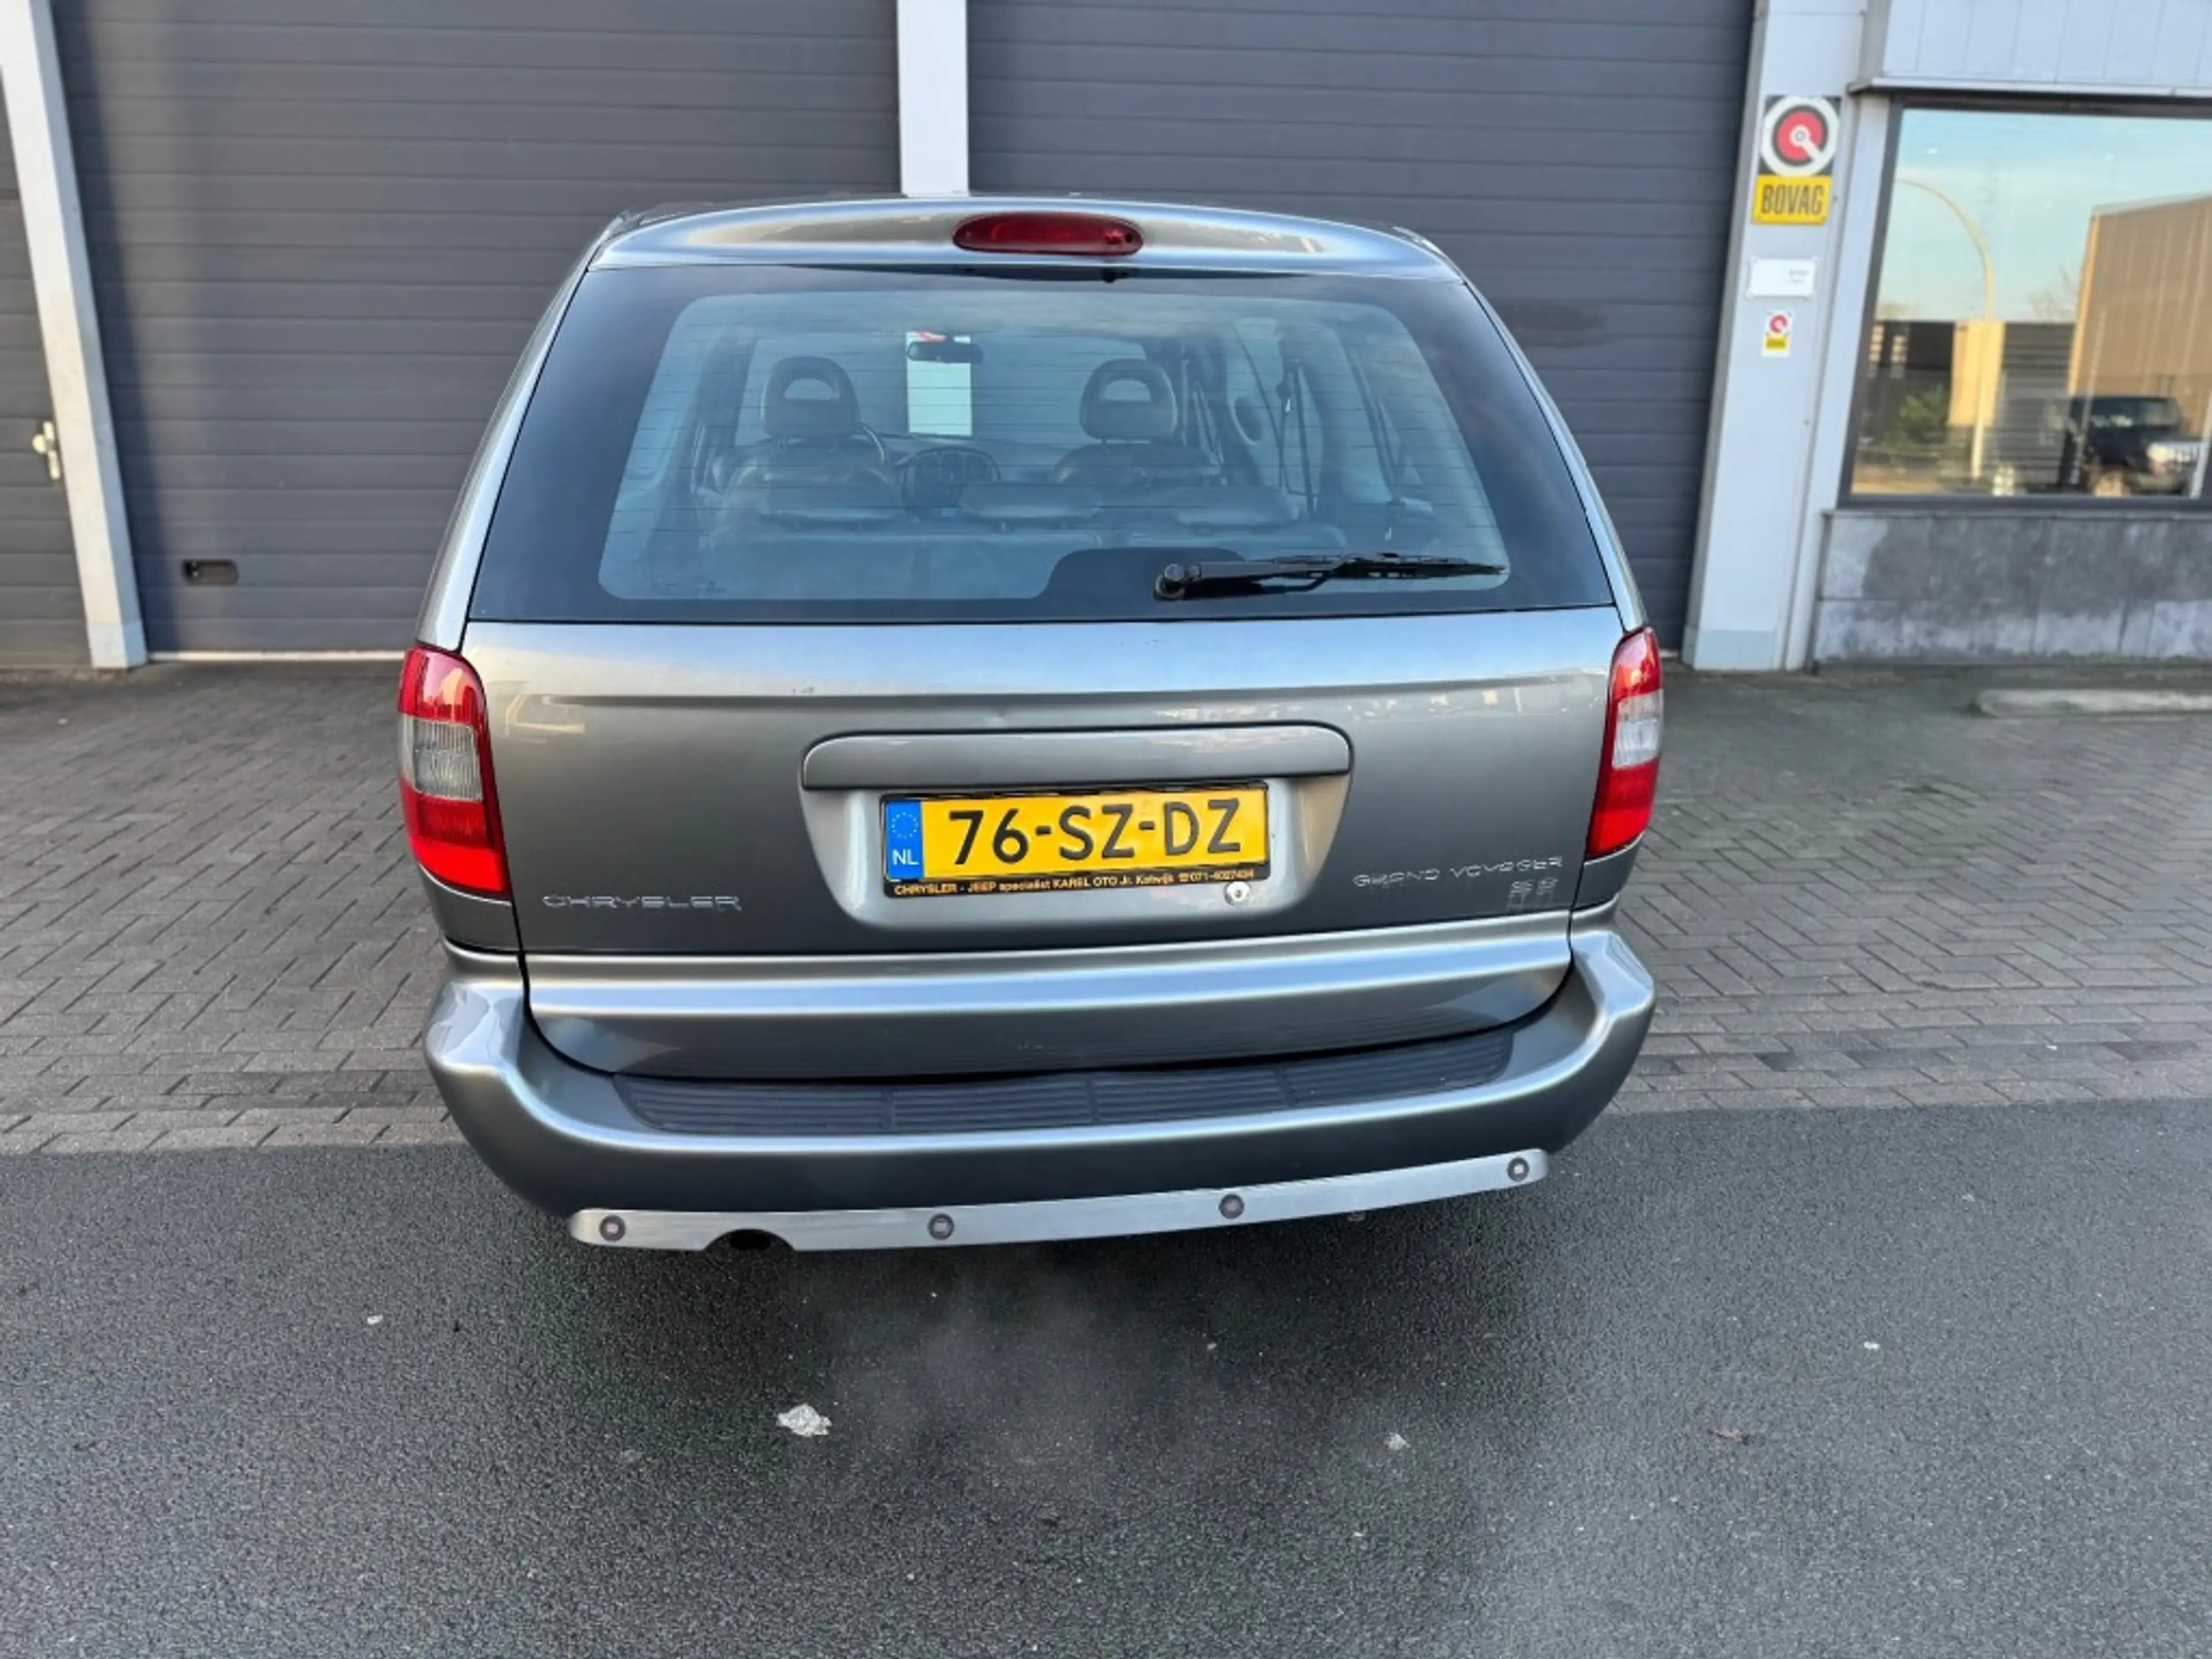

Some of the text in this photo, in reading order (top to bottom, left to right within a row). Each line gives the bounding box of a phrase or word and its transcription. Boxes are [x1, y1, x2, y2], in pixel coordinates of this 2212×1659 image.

[1760, 184, 1824, 216] BOVAG
[949, 798, 1241, 865] 76-SZ-DZ
[892, 848, 919, 865] NL
[1449, 856, 1563, 878] VOYAGER
[894, 881, 957, 896] CHRYSLER
[1093, 876, 1118, 887] OTO
[542, 895, 743, 912] CHRYSLER
